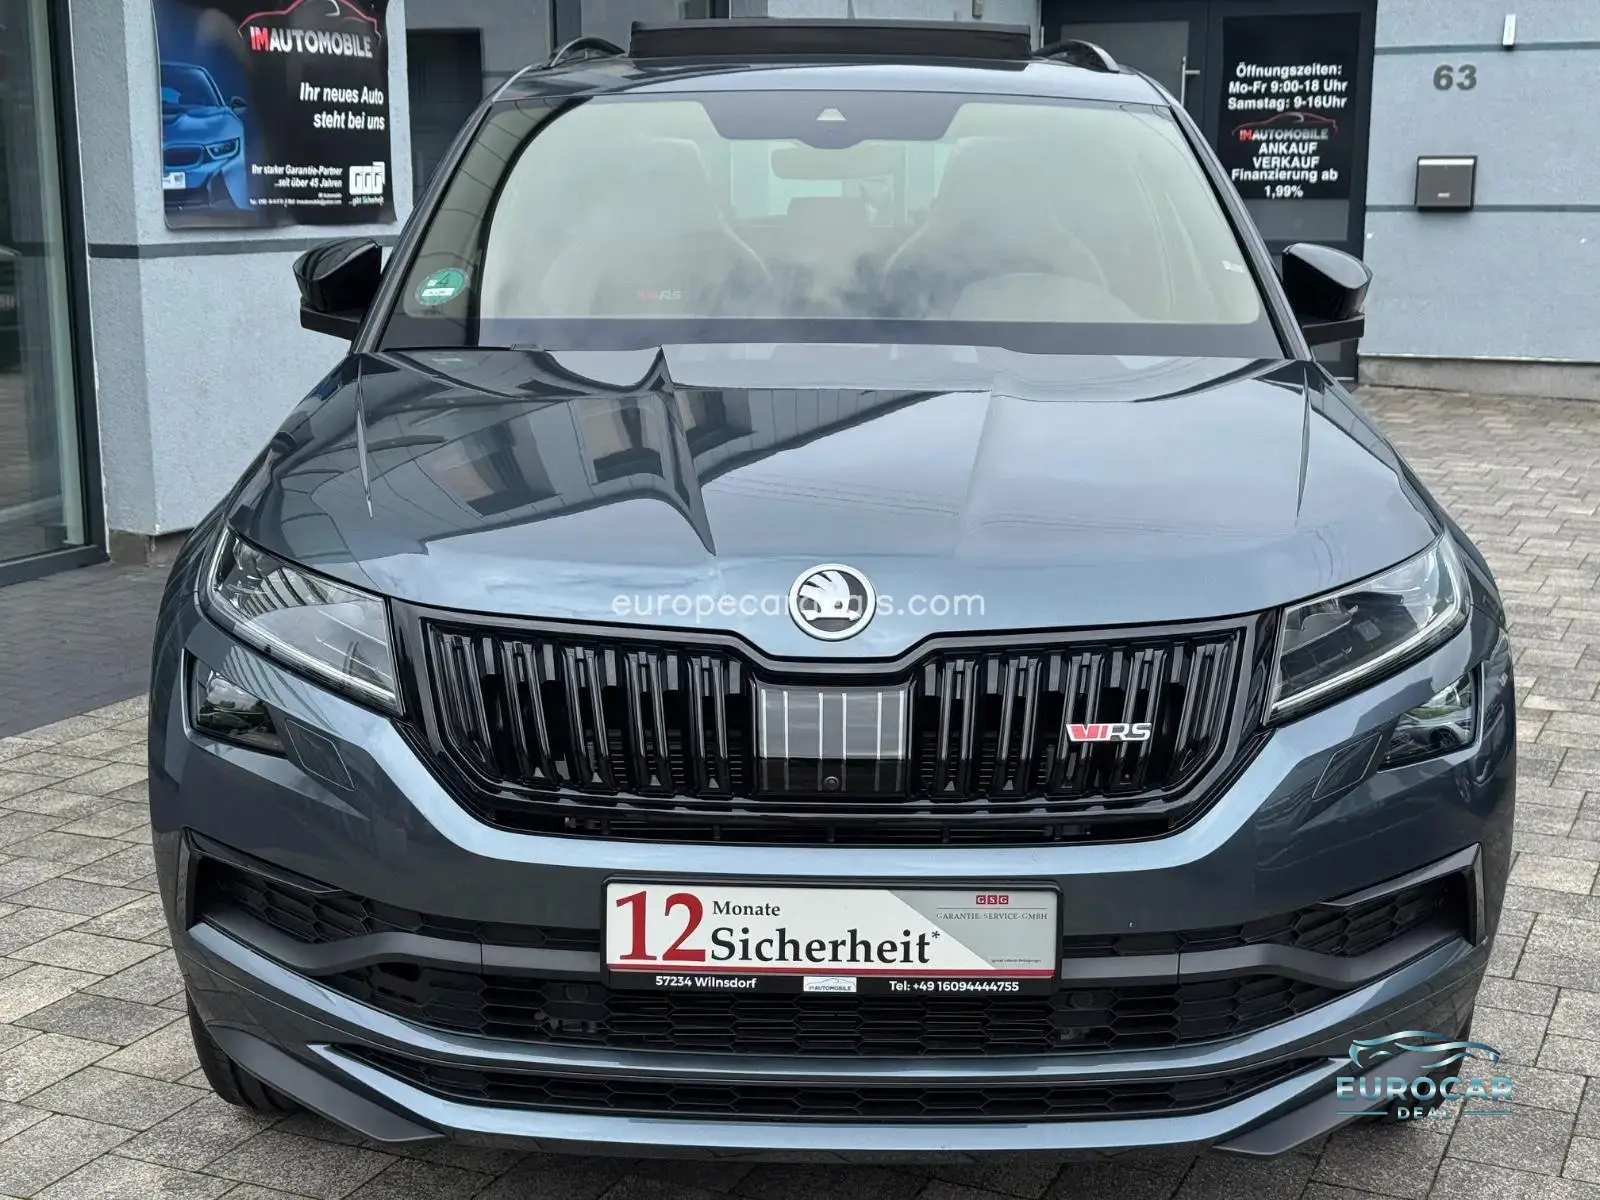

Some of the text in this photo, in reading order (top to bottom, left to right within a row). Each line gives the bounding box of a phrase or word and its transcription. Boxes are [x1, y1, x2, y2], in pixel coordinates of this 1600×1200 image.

[250, 26, 373, 58] IMAUTOMOBILE
[1236, 62, 1343, 80] Öffnungszeiten:
[1433, 64, 1478, 91] 63
[300, 82, 384, 105] Ihr neues Auto
[1228, 79, 1348, 94] Mo-Fr 9:00-18 Uhr
[1227, 97, 1290, 111] Samstag:
[313, 110, 386, 131] steht bei uns
[1239, 129, 1329, 140] IMAUTOMOBILE
[1258, 142, 1318, 154] ANKAUF
[251, 164, 262, 175] Ihr
[1252, 156, 1320, 169] VERKAUF
[291, 177, 308, 188] über
[319, 178, 343, 188] Jahren
[1231, 168, 1339, 183] Finanzierung ab
[1264, 185, 1304, 198] 1,99%
[976, 895, 1009, 905] GSG
[712, 899, 781, 917] Monate
[615, 889, 706, 963] 12
[655, 976, 757, 989] 57234 Wilnsdorf
[889, 980, 1020, 992] Tel: +49 16094444755
